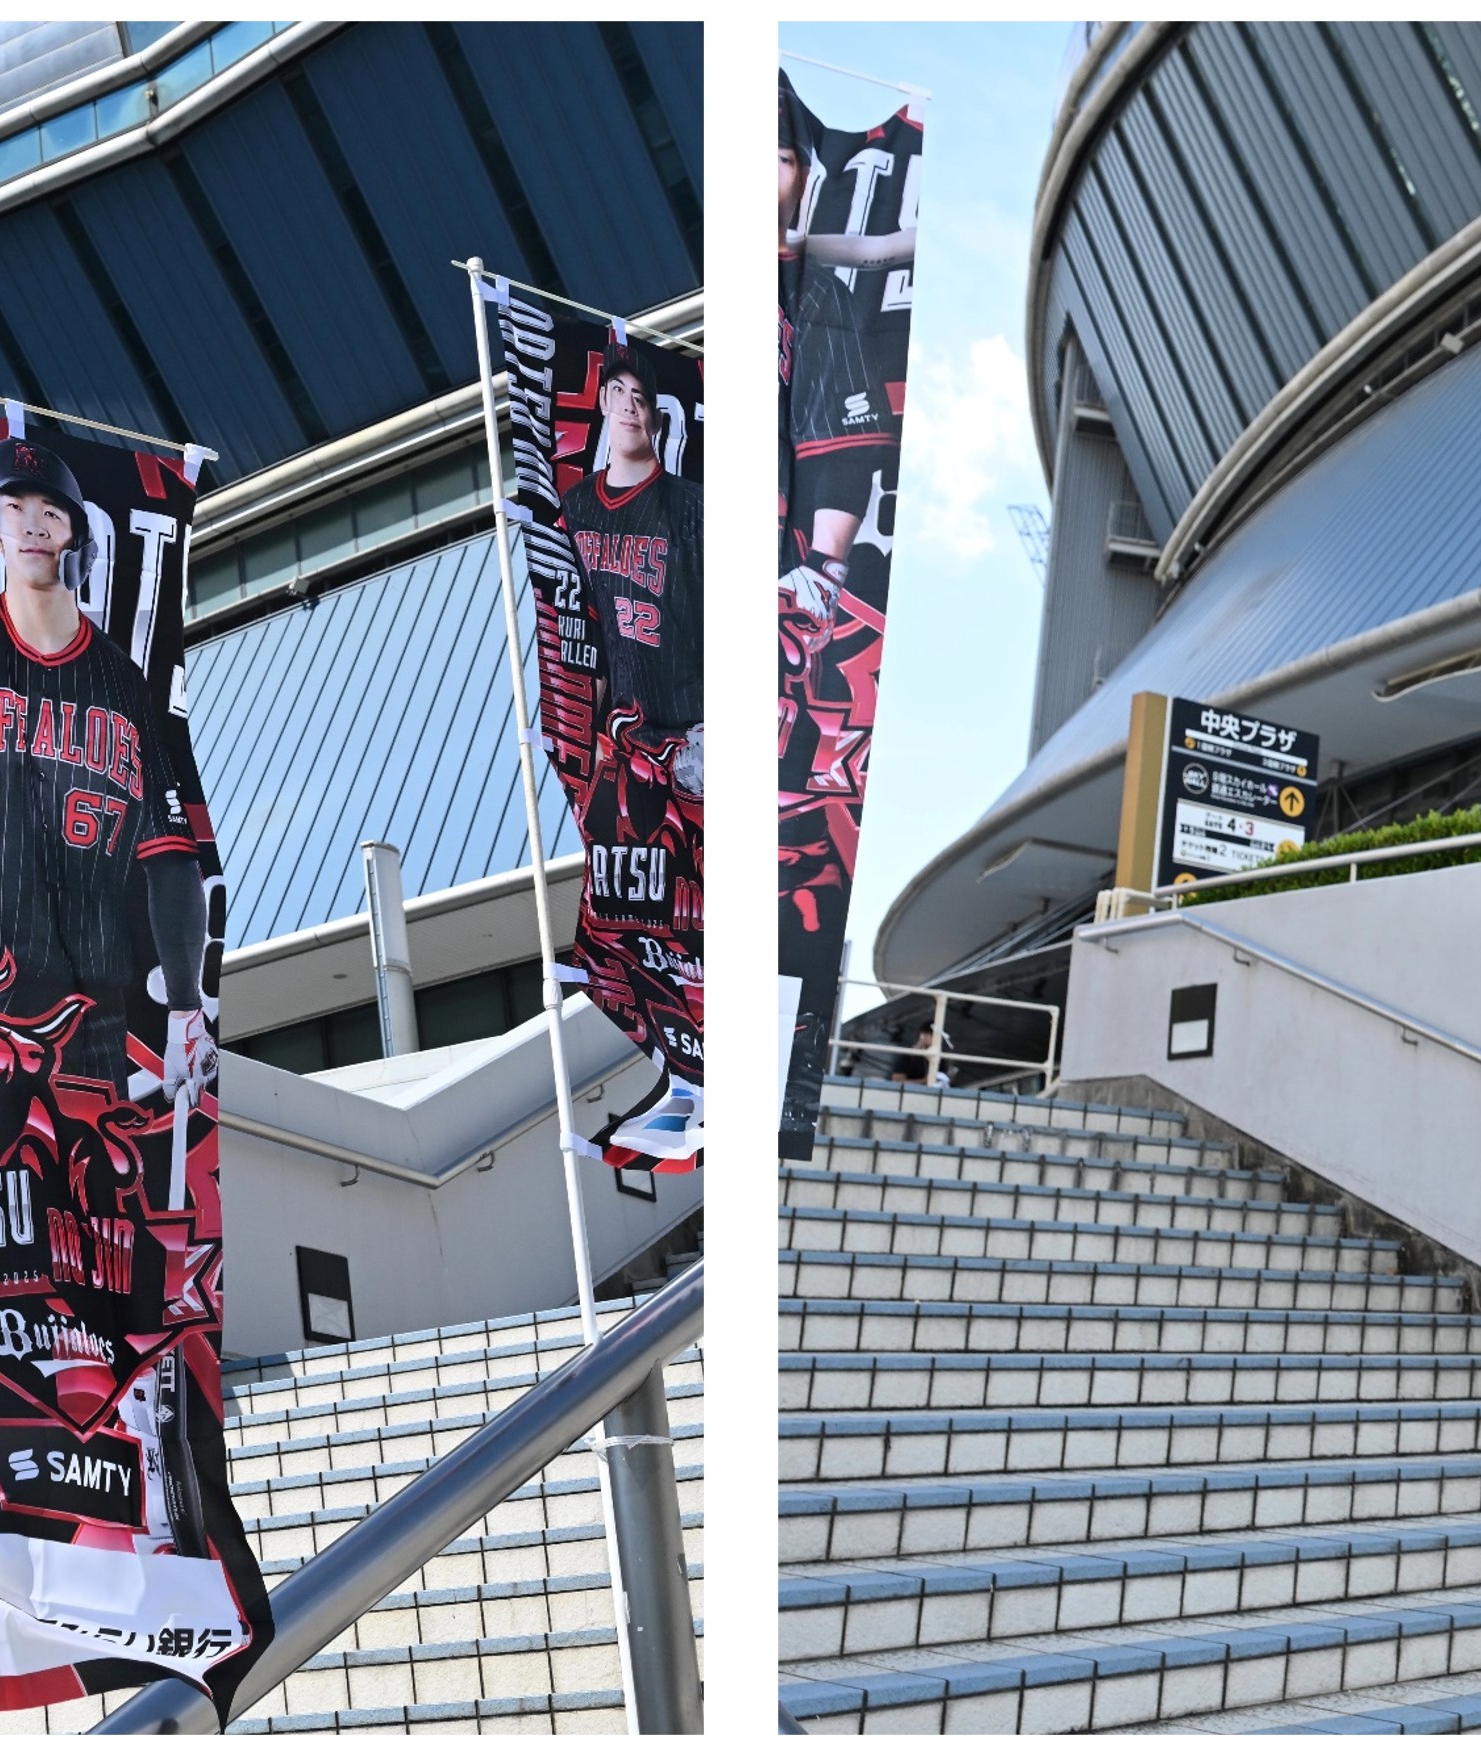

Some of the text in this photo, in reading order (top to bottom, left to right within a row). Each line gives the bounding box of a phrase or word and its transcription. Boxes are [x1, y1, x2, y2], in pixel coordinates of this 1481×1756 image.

[841, 413, 879, 427] SAMTY
[554, 568, 581, 612] 22
[558, 615, 586, 641] KURI
[614, 596, 660, 647] 22
[560, 639, 597, 670] ALLEN
[1200, 708, 1298, 753] 中央プラザ
[64, 789, 129, 857] 67
[47, 1207, 135, 1295] NO JIN
[3, 1270, 39, 1286] 2025
[50, 1450, 131, 1497] SAMTY
